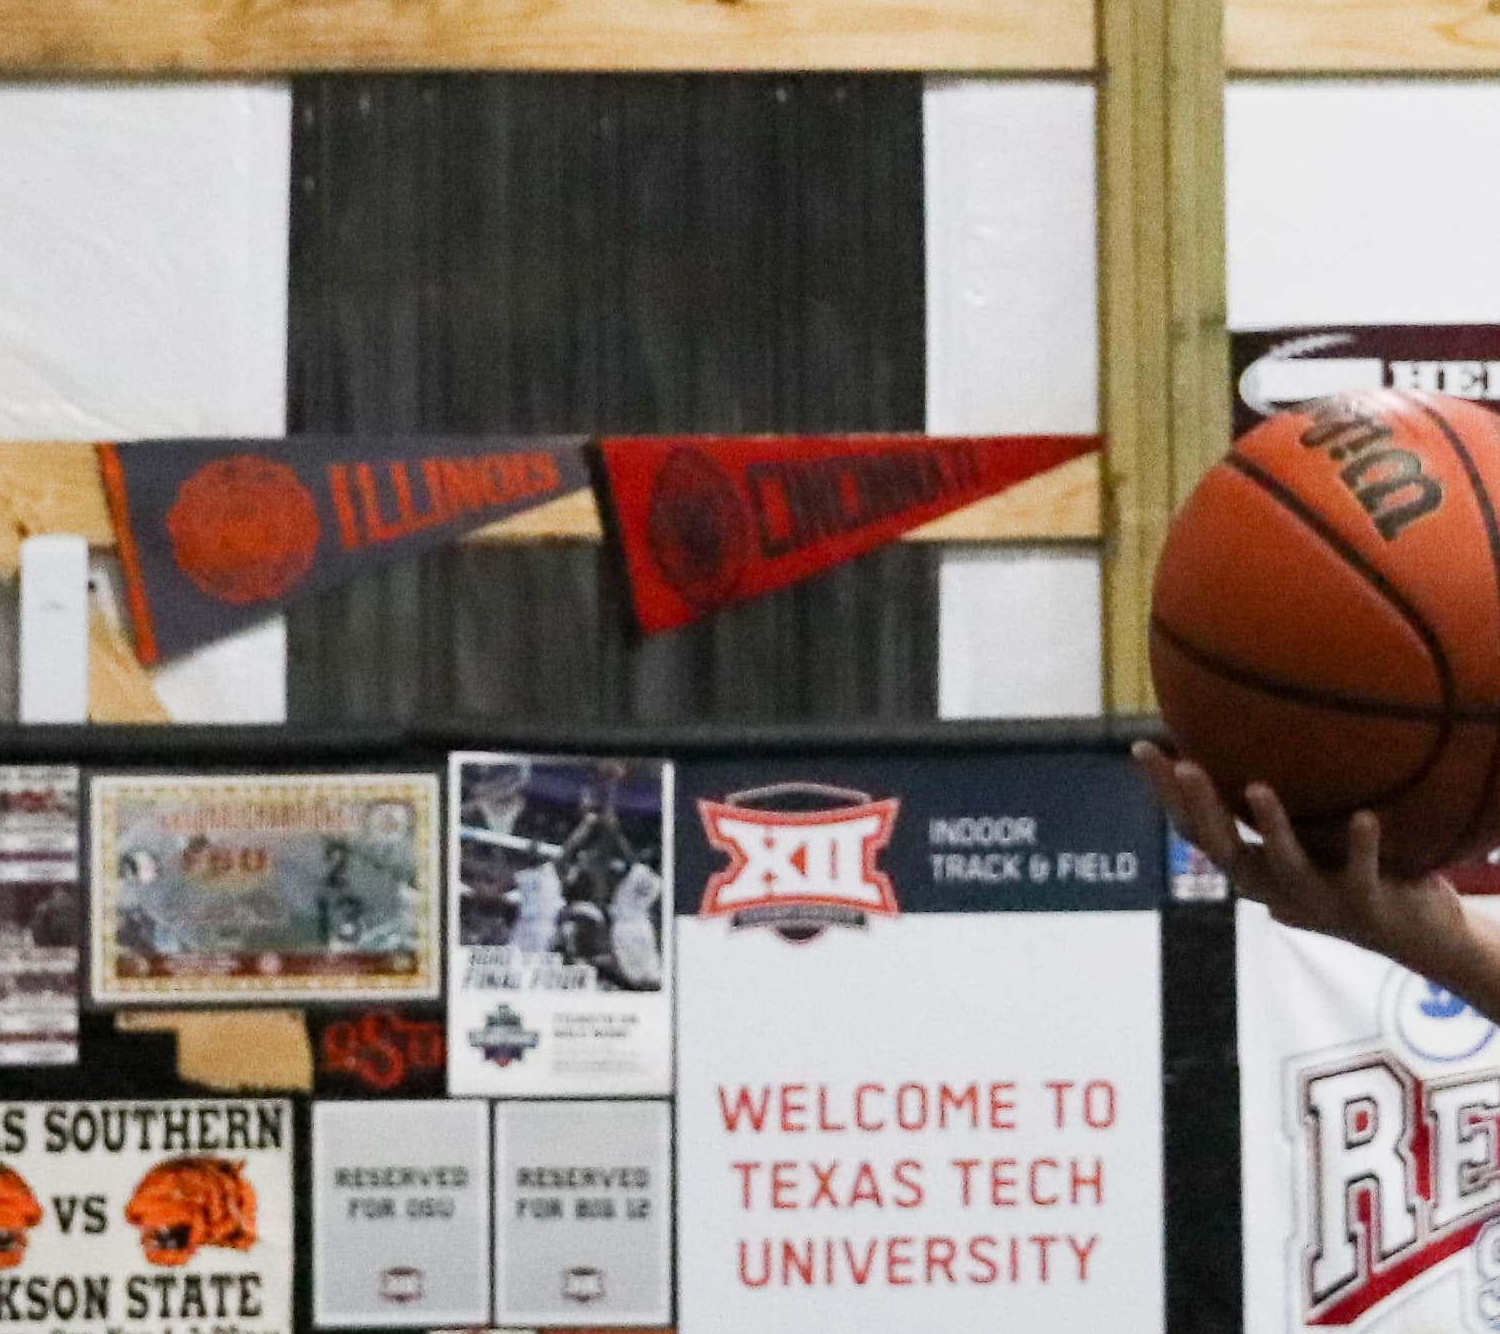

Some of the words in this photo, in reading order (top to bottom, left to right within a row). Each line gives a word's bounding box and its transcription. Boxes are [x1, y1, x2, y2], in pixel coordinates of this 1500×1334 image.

[928, 816, 1037, 846] INDOOR
[930, 853, 1021, 883] TRACK
[1056, 852, 1139, 882] FIELD
[716, 1081, 1019, 1134] WELCOME
[1045, 1080, 1118, 1131] TO
[43, 1104, 286, 1153] SOUTHERN
[333, 1166, 470, 1189] RESERVED
[515, 1166, 650, 1189] RESERVED
[730, 1160, 926, 1211] TEXAS
[951, 1156, 1105, 1208] TECH
[54, 1195, 109, 1235] VS
[347, 1197, 396, 1220] FOR
[514, 1197, 563, 1220] FOR
[738, 1234, 1100, 1288] UNIVERSITY
[126, 1274, 264, 1320] STATE
